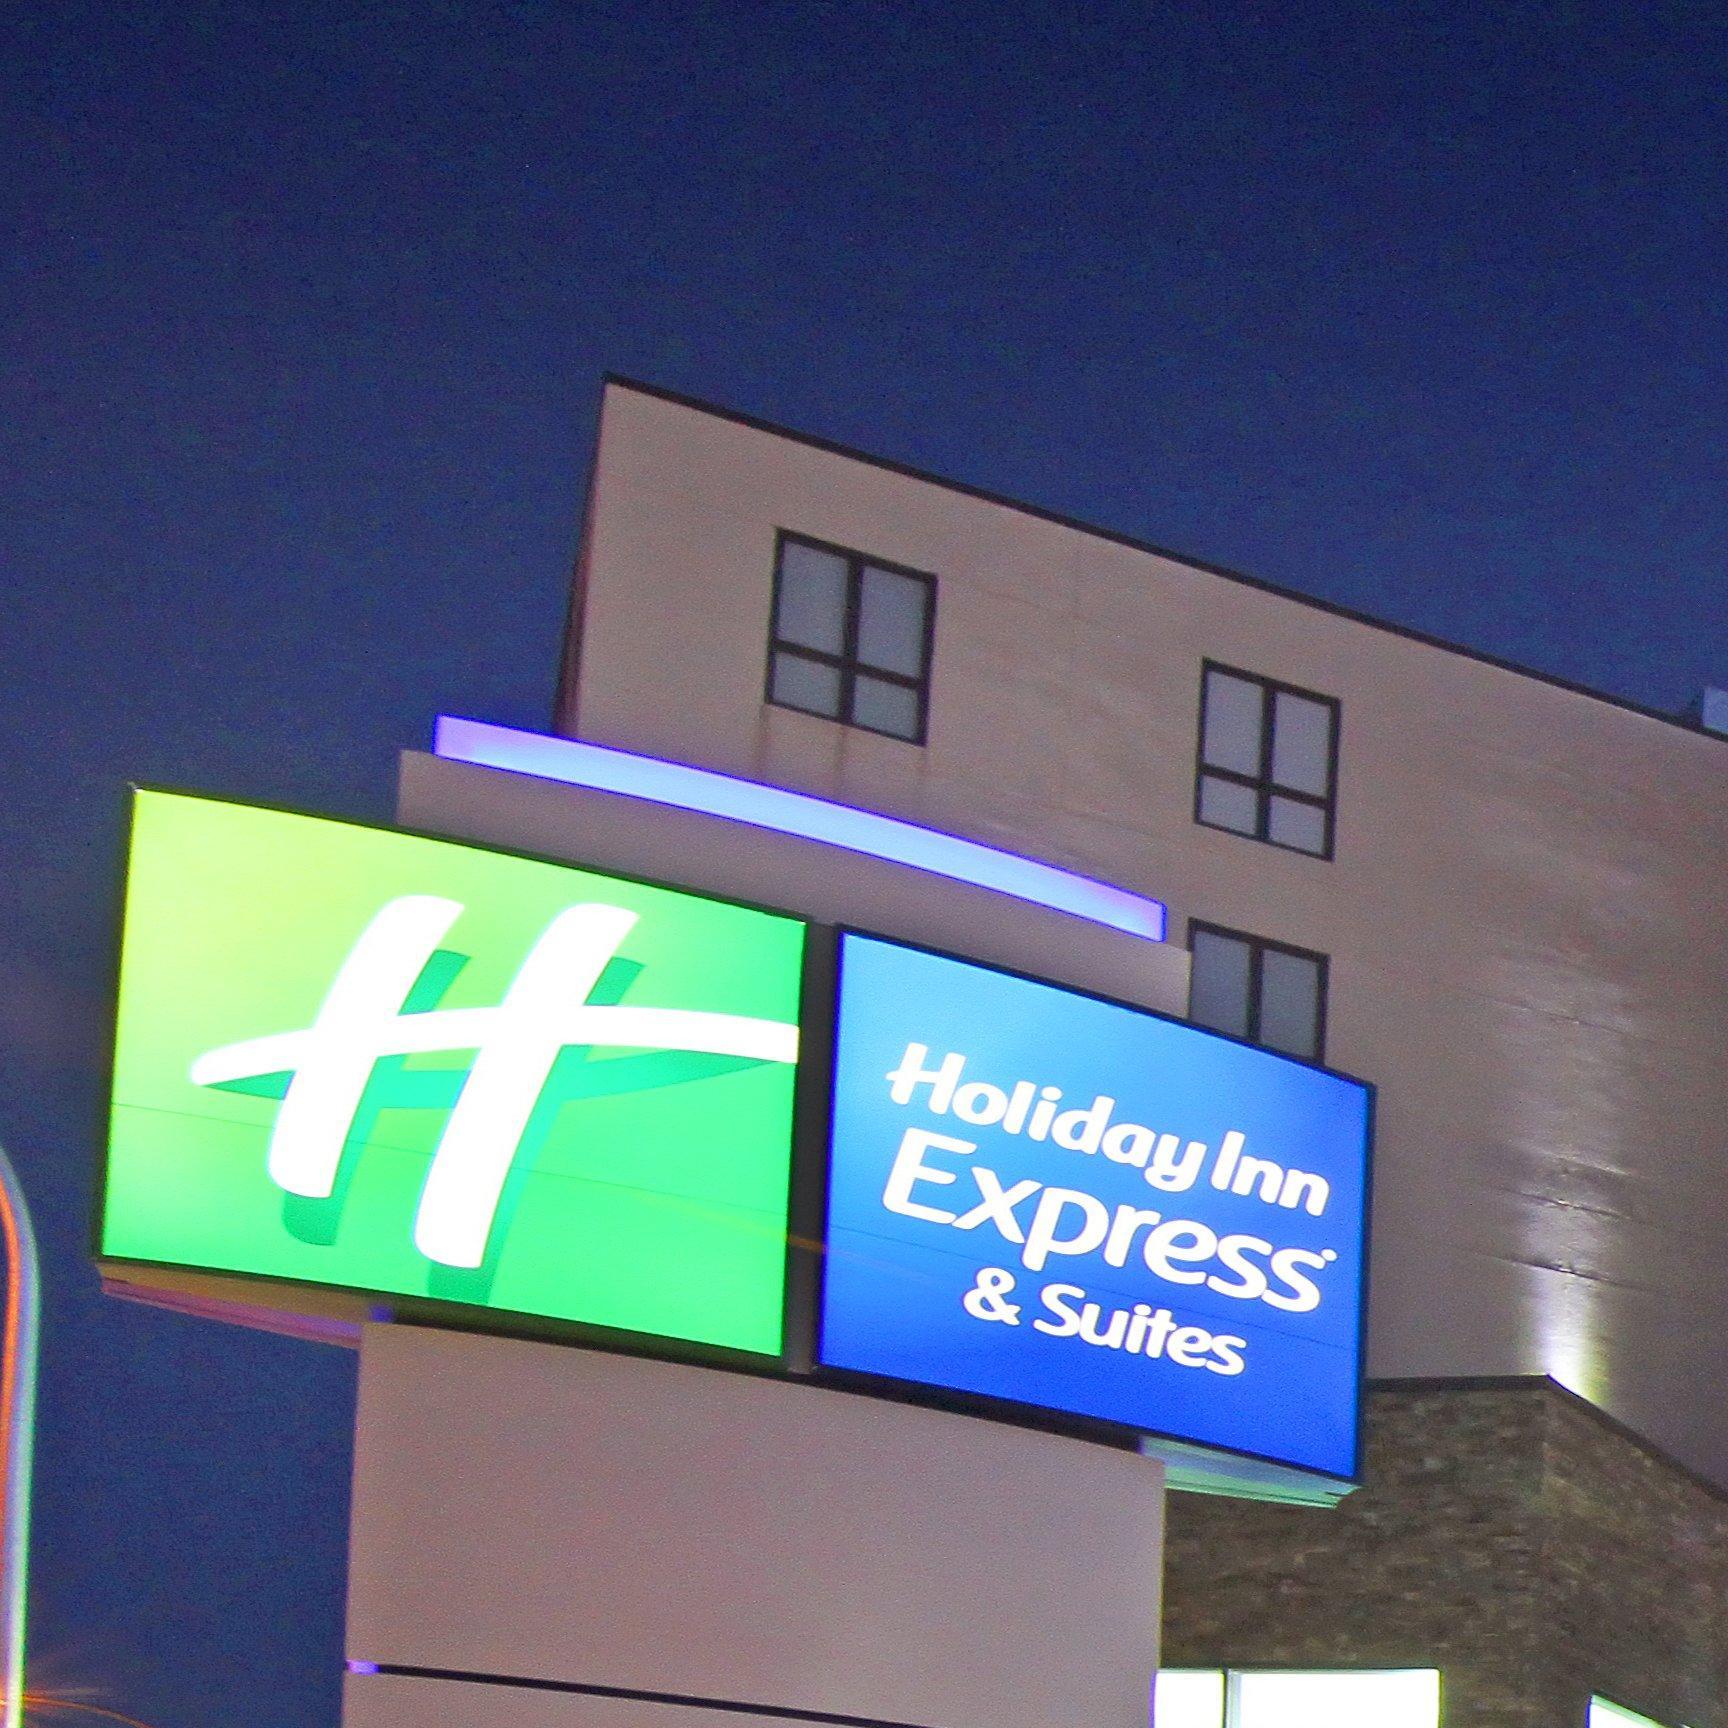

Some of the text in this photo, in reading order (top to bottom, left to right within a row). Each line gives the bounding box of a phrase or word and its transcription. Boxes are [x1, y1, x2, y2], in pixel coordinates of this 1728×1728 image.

[885, 1042, 1331, 1217] Holiday Inn
[881, 1126, 1326, 1314] Express
[962, 1266, 1248, 1377] & Suites
